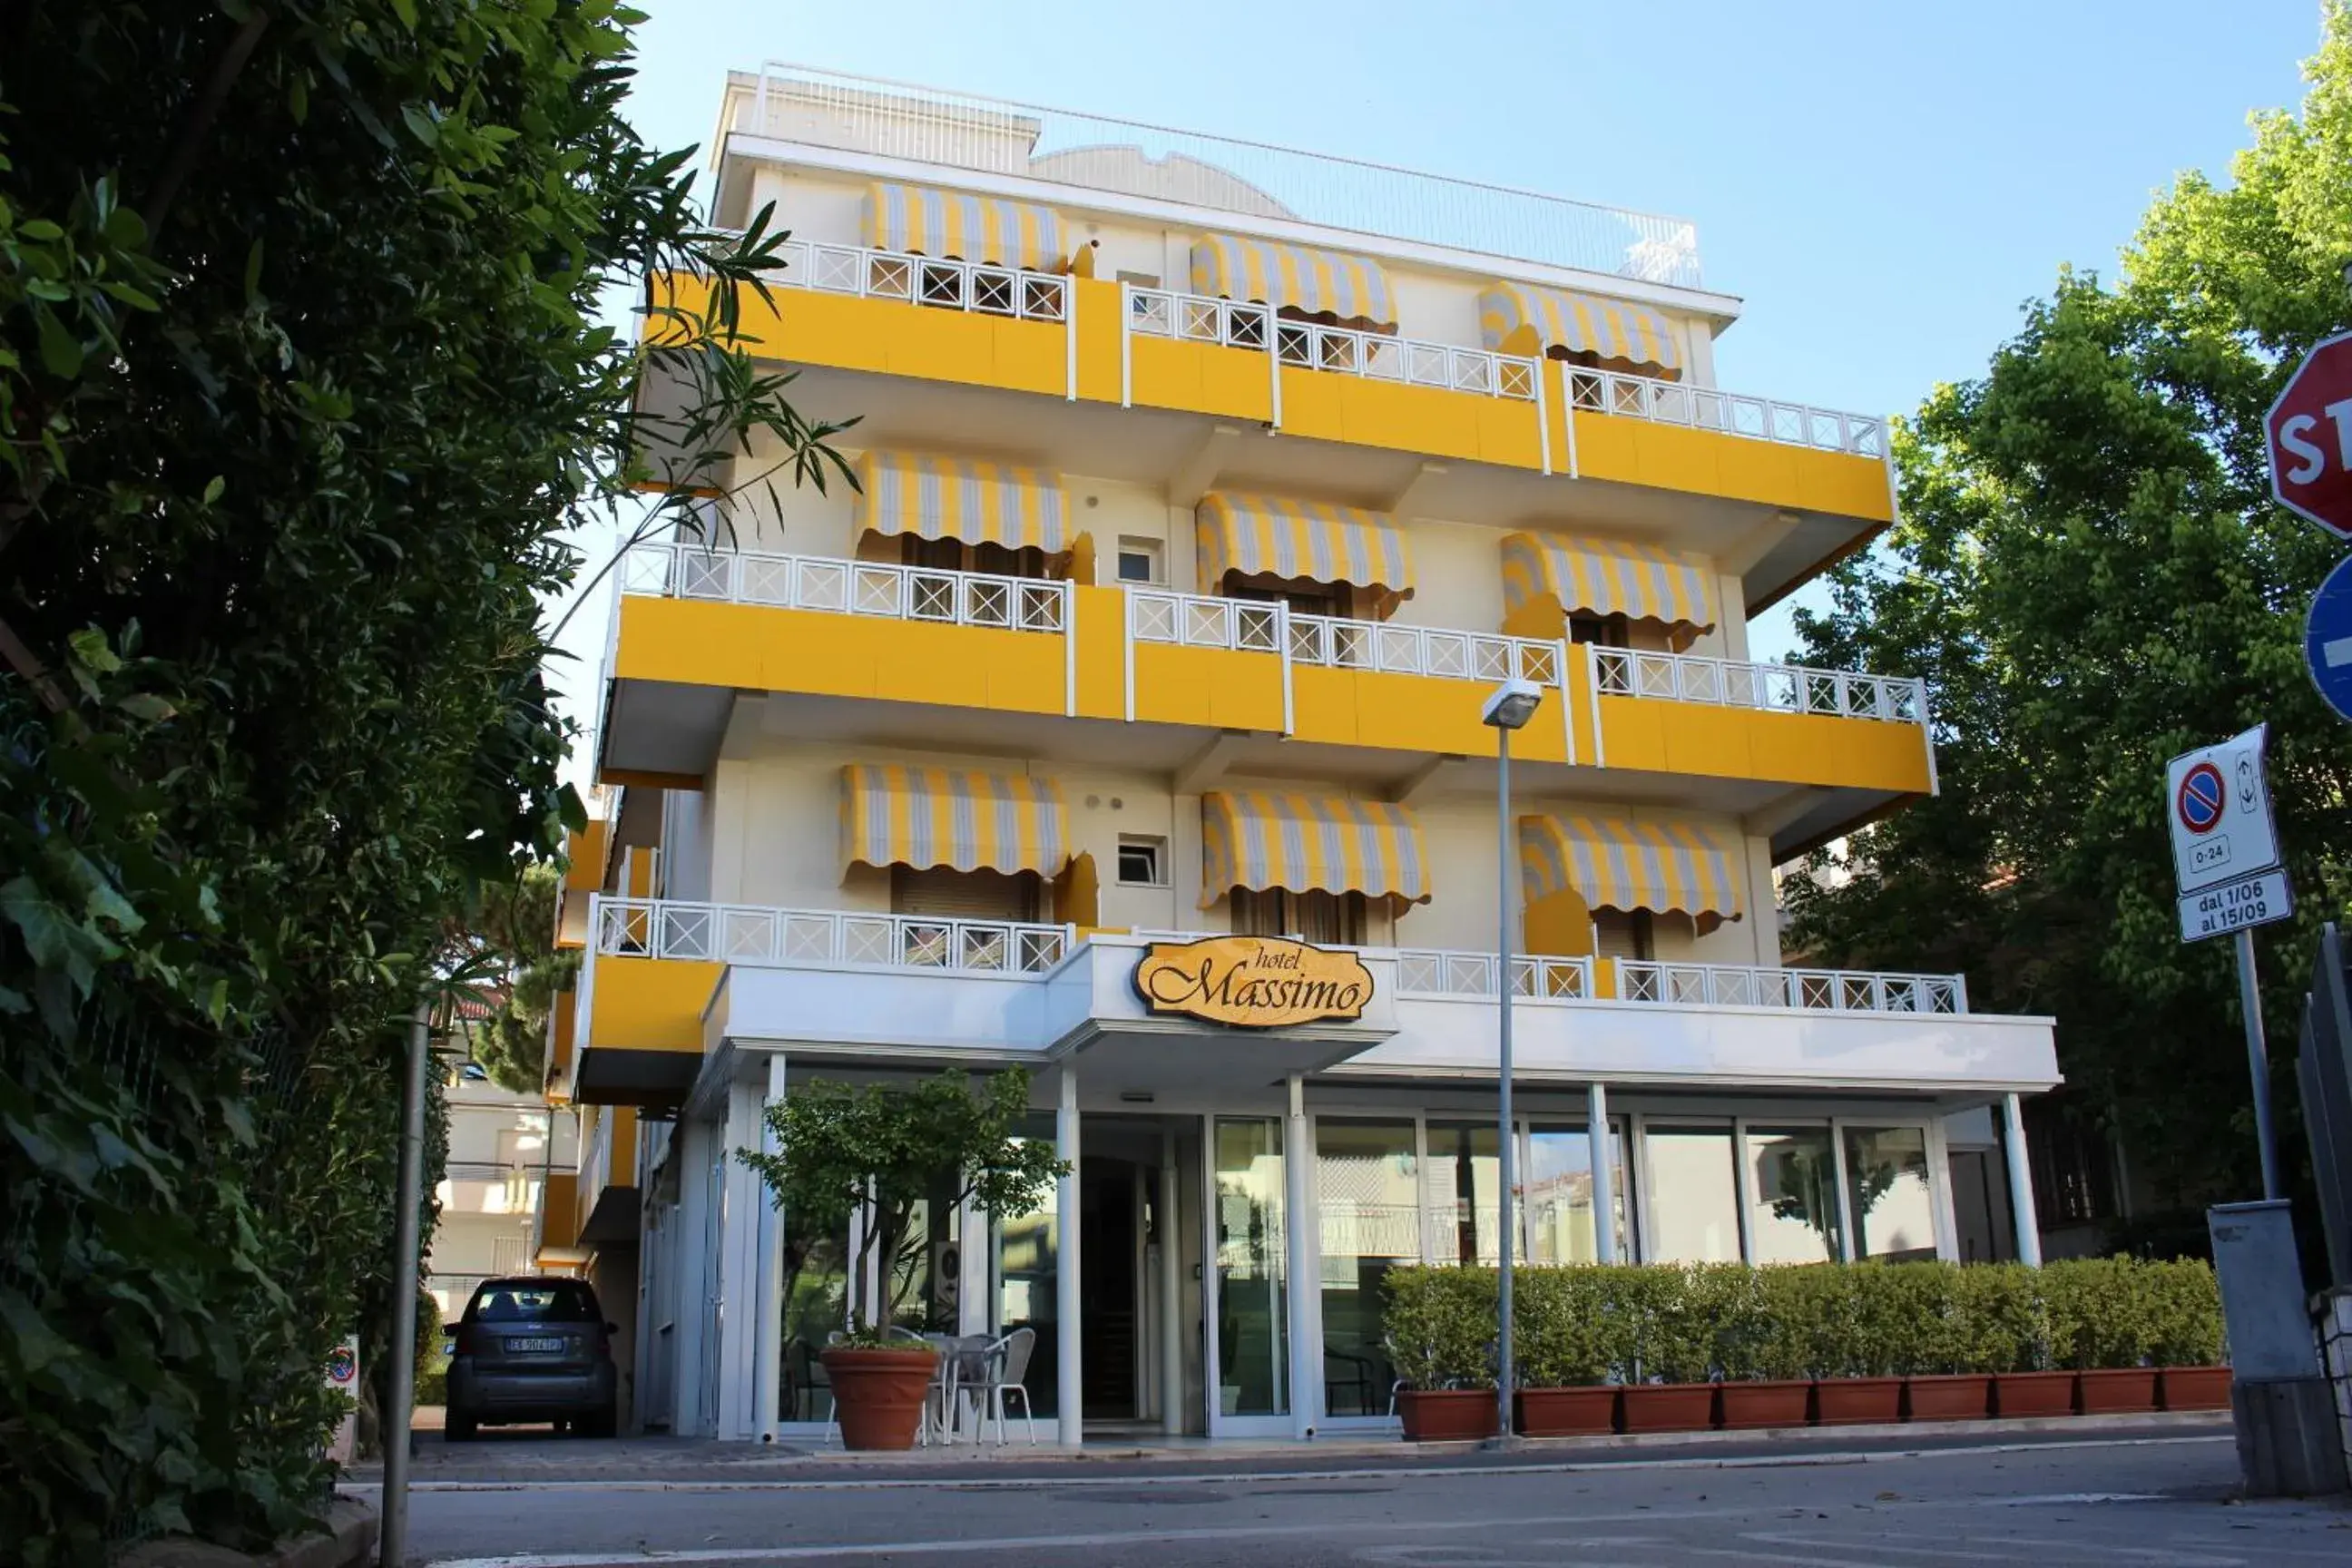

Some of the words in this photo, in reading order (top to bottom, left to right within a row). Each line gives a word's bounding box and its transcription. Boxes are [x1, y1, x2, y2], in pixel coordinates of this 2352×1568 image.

[2196, 845, 2223, 863] 0-24
[2200, 893, 2222, 913] dal
[2227, 881, 2264, 904] 1/06
[2201, 915, 2217, 932] al
[2221, 901, 2268, 926] 15/09
[1255, 946, 1301, 970] hotel
[1149, 958, 1360, 1010] Massimo
